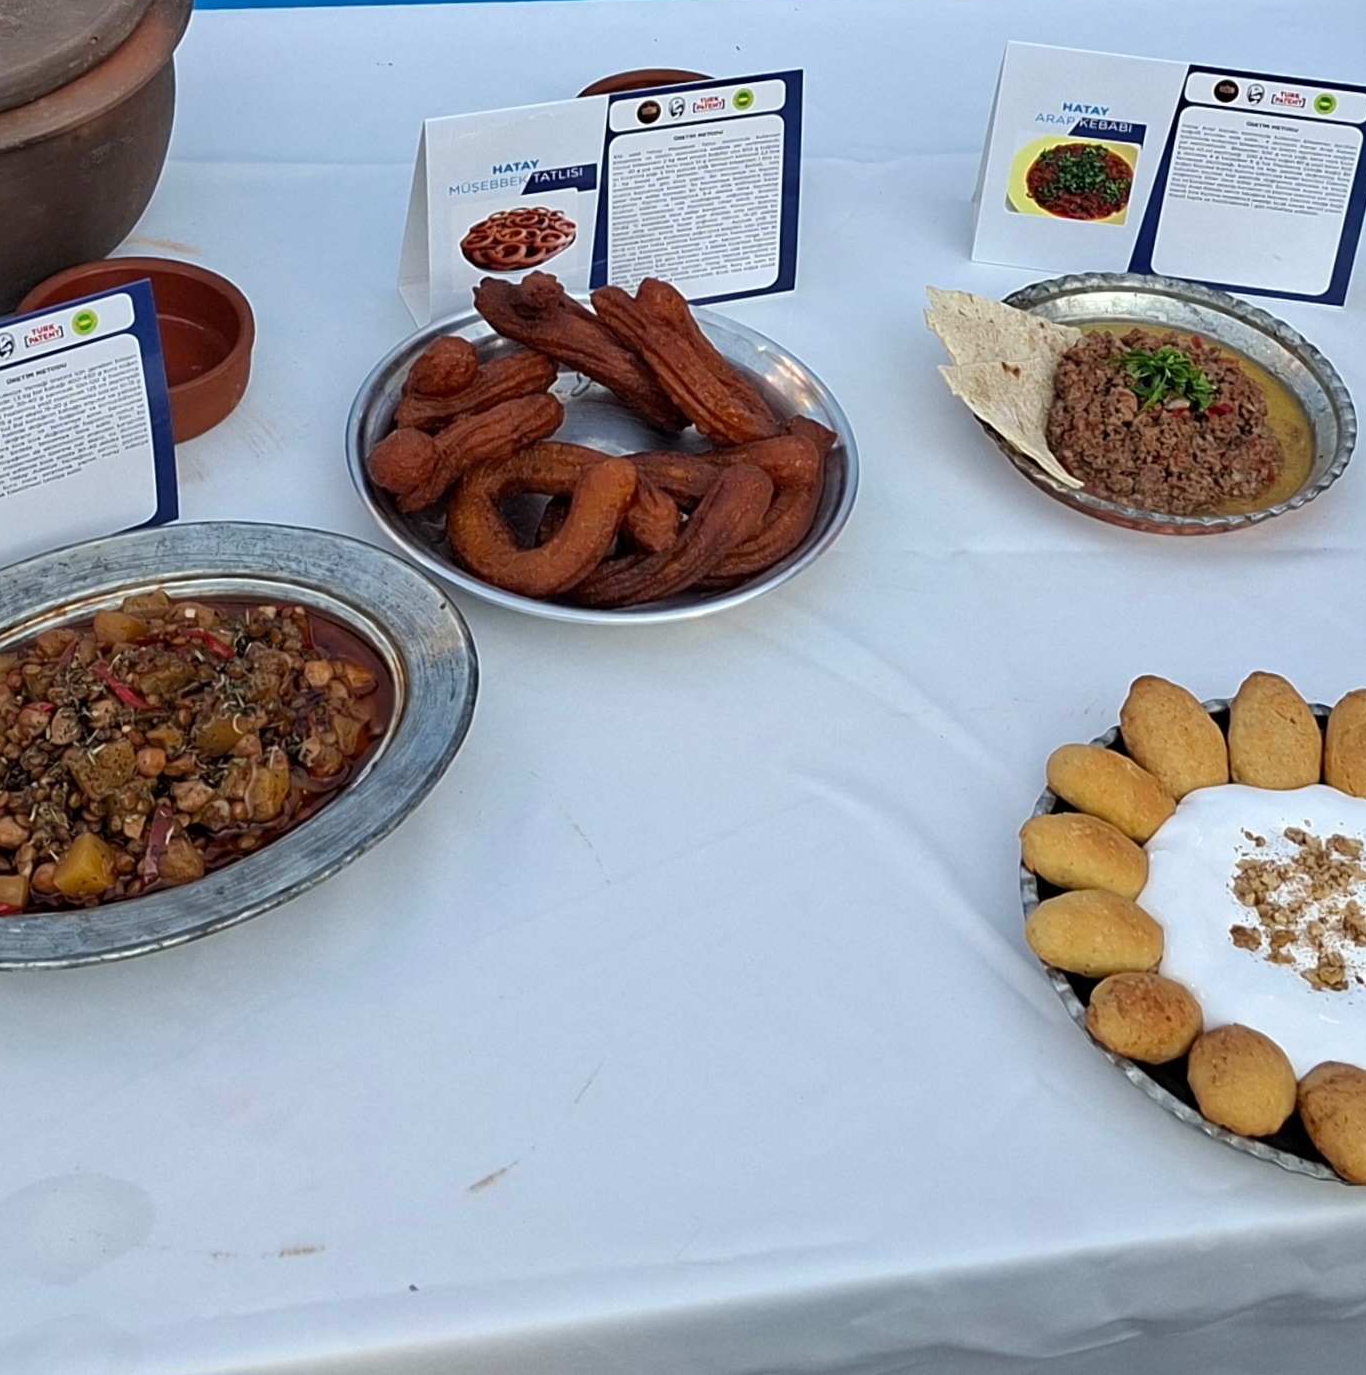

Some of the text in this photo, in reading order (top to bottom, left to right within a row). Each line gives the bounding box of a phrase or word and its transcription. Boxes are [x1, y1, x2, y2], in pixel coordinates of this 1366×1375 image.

[1062, 102, 1110, 116] HATAY
[1035, 113, 1133, 133] ARAP KEBABI
[492, 159, 540, 175] HATAY
[533, 167, 583, 183] TATLISI
